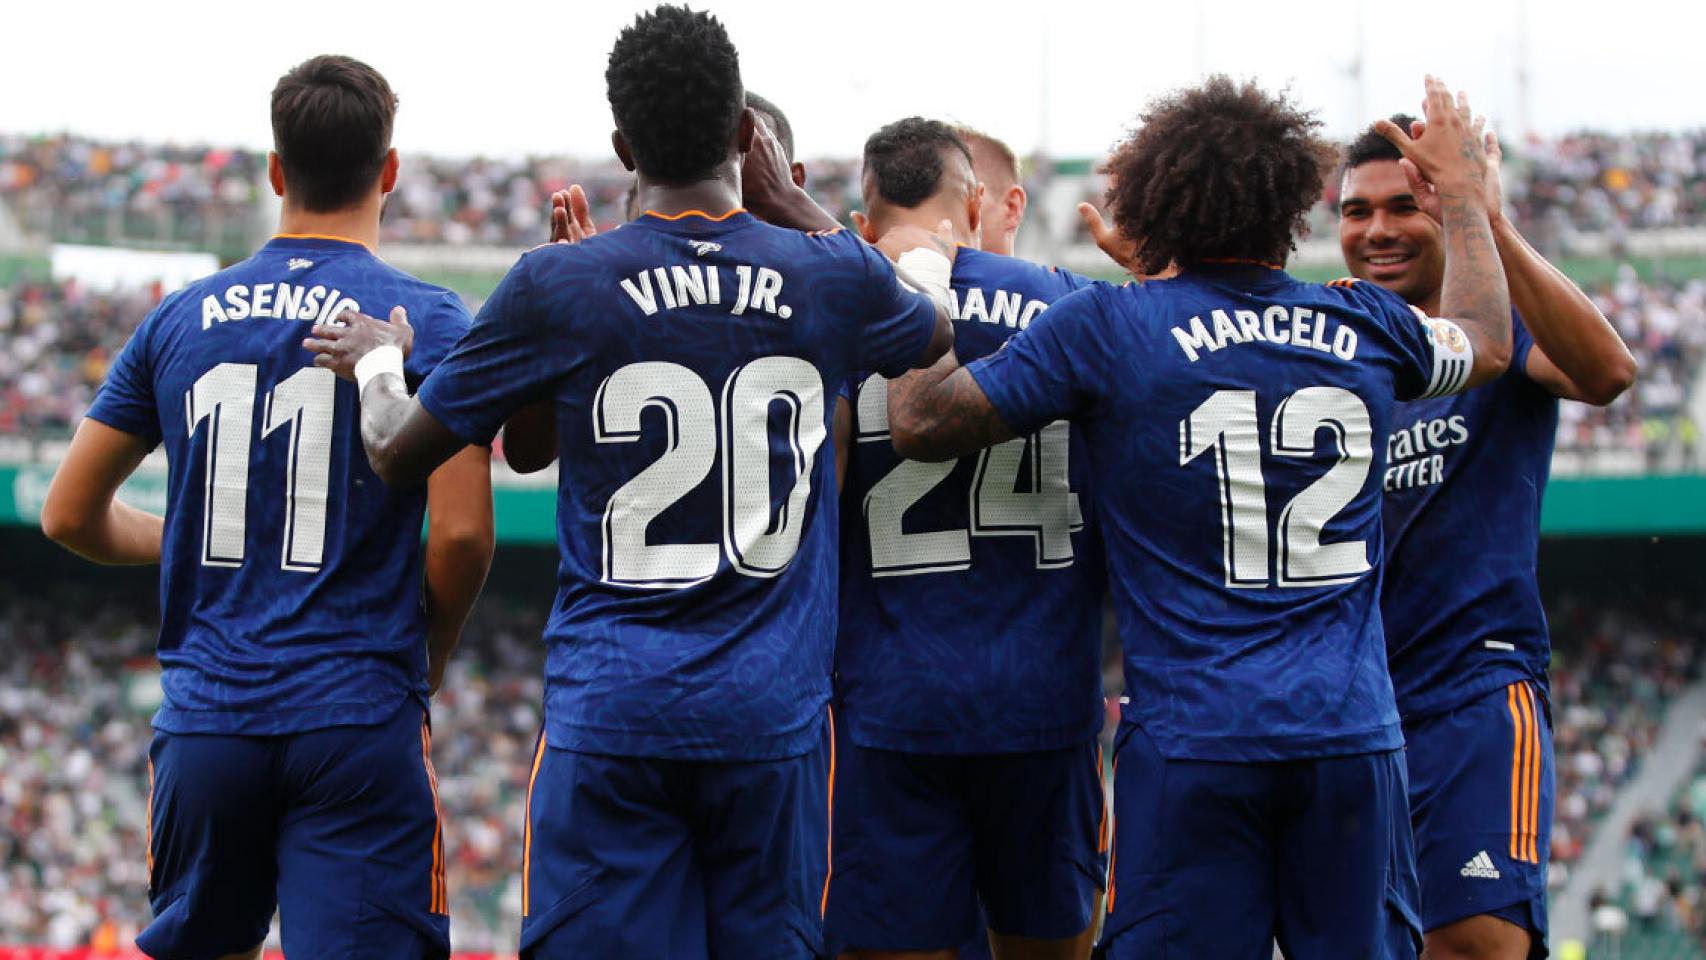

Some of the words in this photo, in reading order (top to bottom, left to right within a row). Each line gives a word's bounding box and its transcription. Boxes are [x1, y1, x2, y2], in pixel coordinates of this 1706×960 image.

[620, 265, 720, 316] VINI
[730, 265, 793, 320] JR.
[1170, 305, 1358, 362] MARCELO
[185, 362, 337, 573] 11
[592, 355, 827, 589] 20
[856, 372, 1084, 578] 24
[1179, 386, 1373, 589] 12
[1460, 867, 1500, 879] adidas
